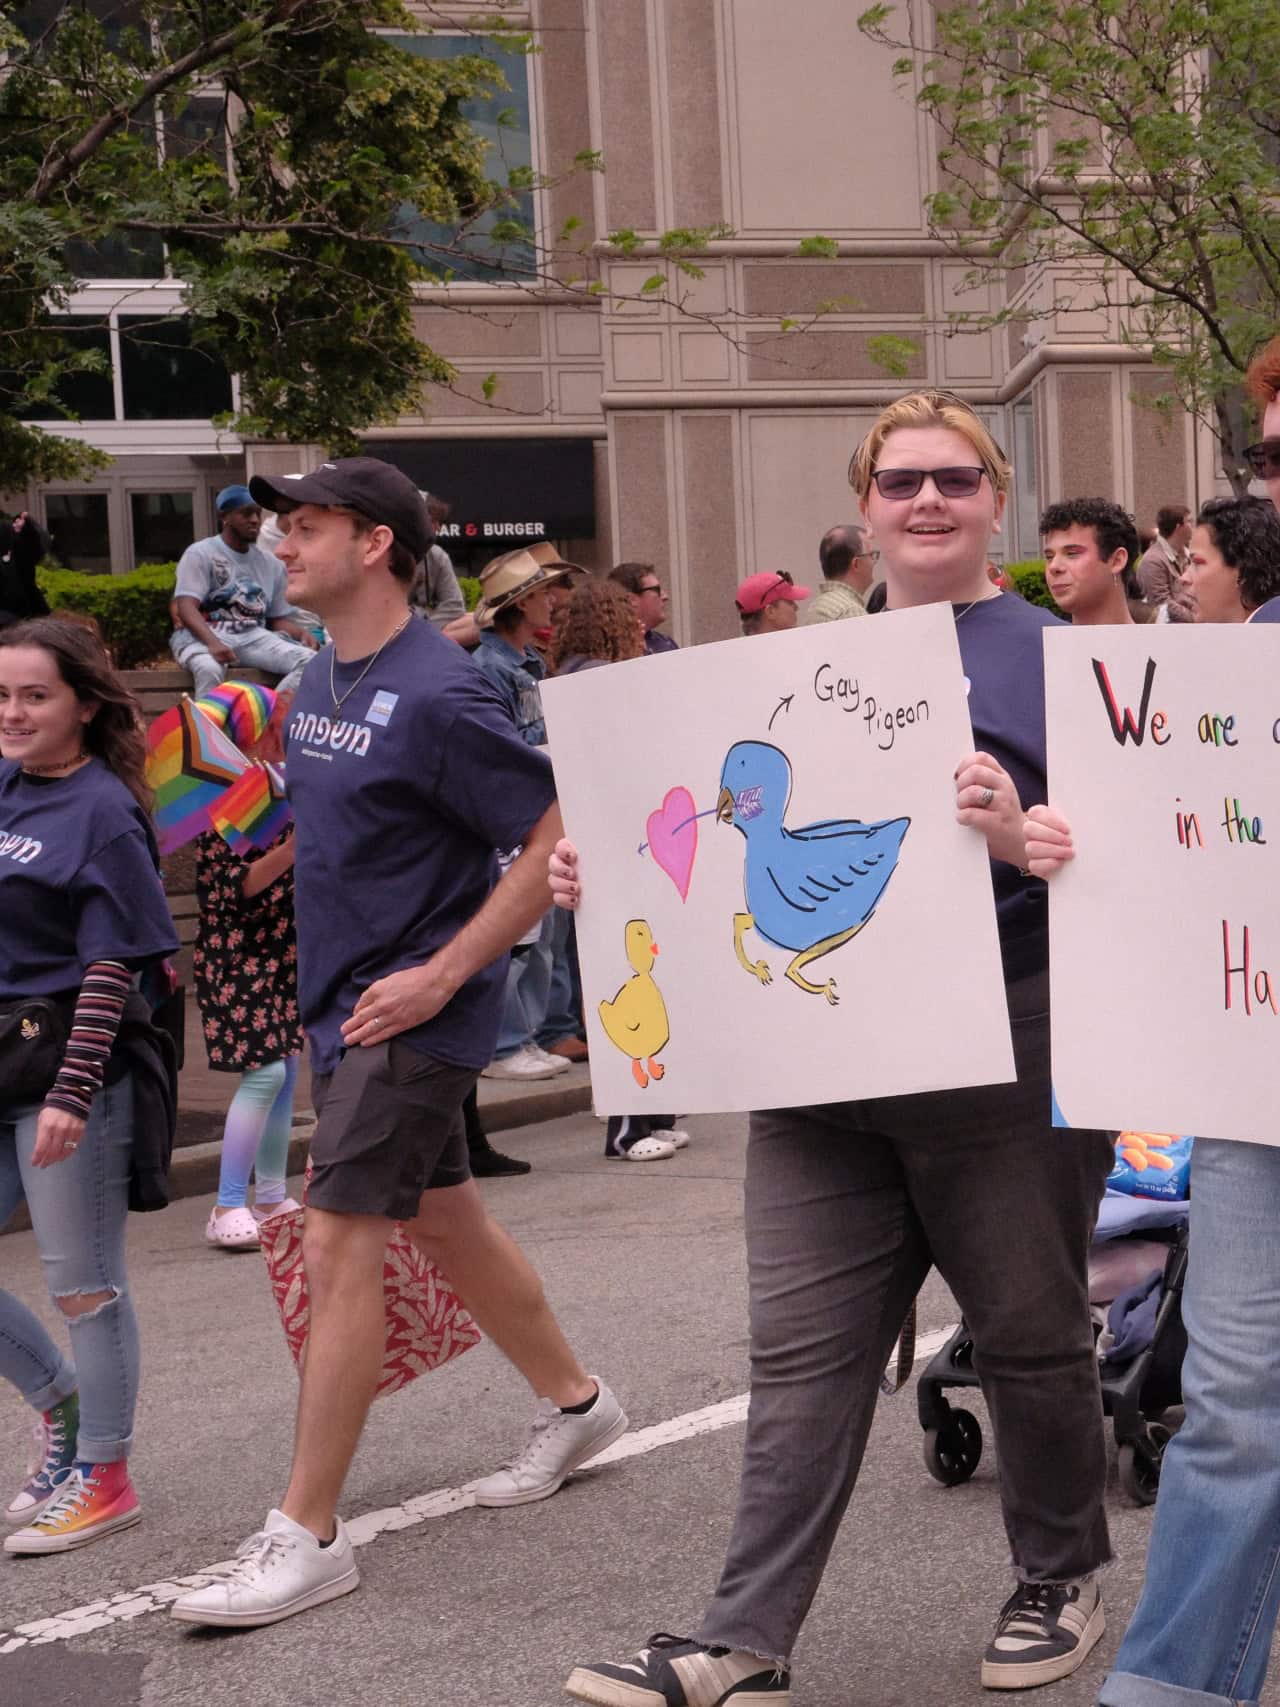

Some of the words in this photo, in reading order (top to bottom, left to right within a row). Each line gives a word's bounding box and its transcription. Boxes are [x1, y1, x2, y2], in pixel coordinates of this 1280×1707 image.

[435, 524, 461, 536] AR
[465, 523, 478, 536] &
[483, 522, 545, 536] BURGER
[814, 663, 860, 712] Gay
[1092, 656, 1171, 747] We
[1197, 712, 1239, 747] are
[289, 711, 371, 756] משפחה
[863, 696, 929, 750] Pigeon
[1175, 797, 1206, 849] in
[1221, 796, 1266, 845] the
